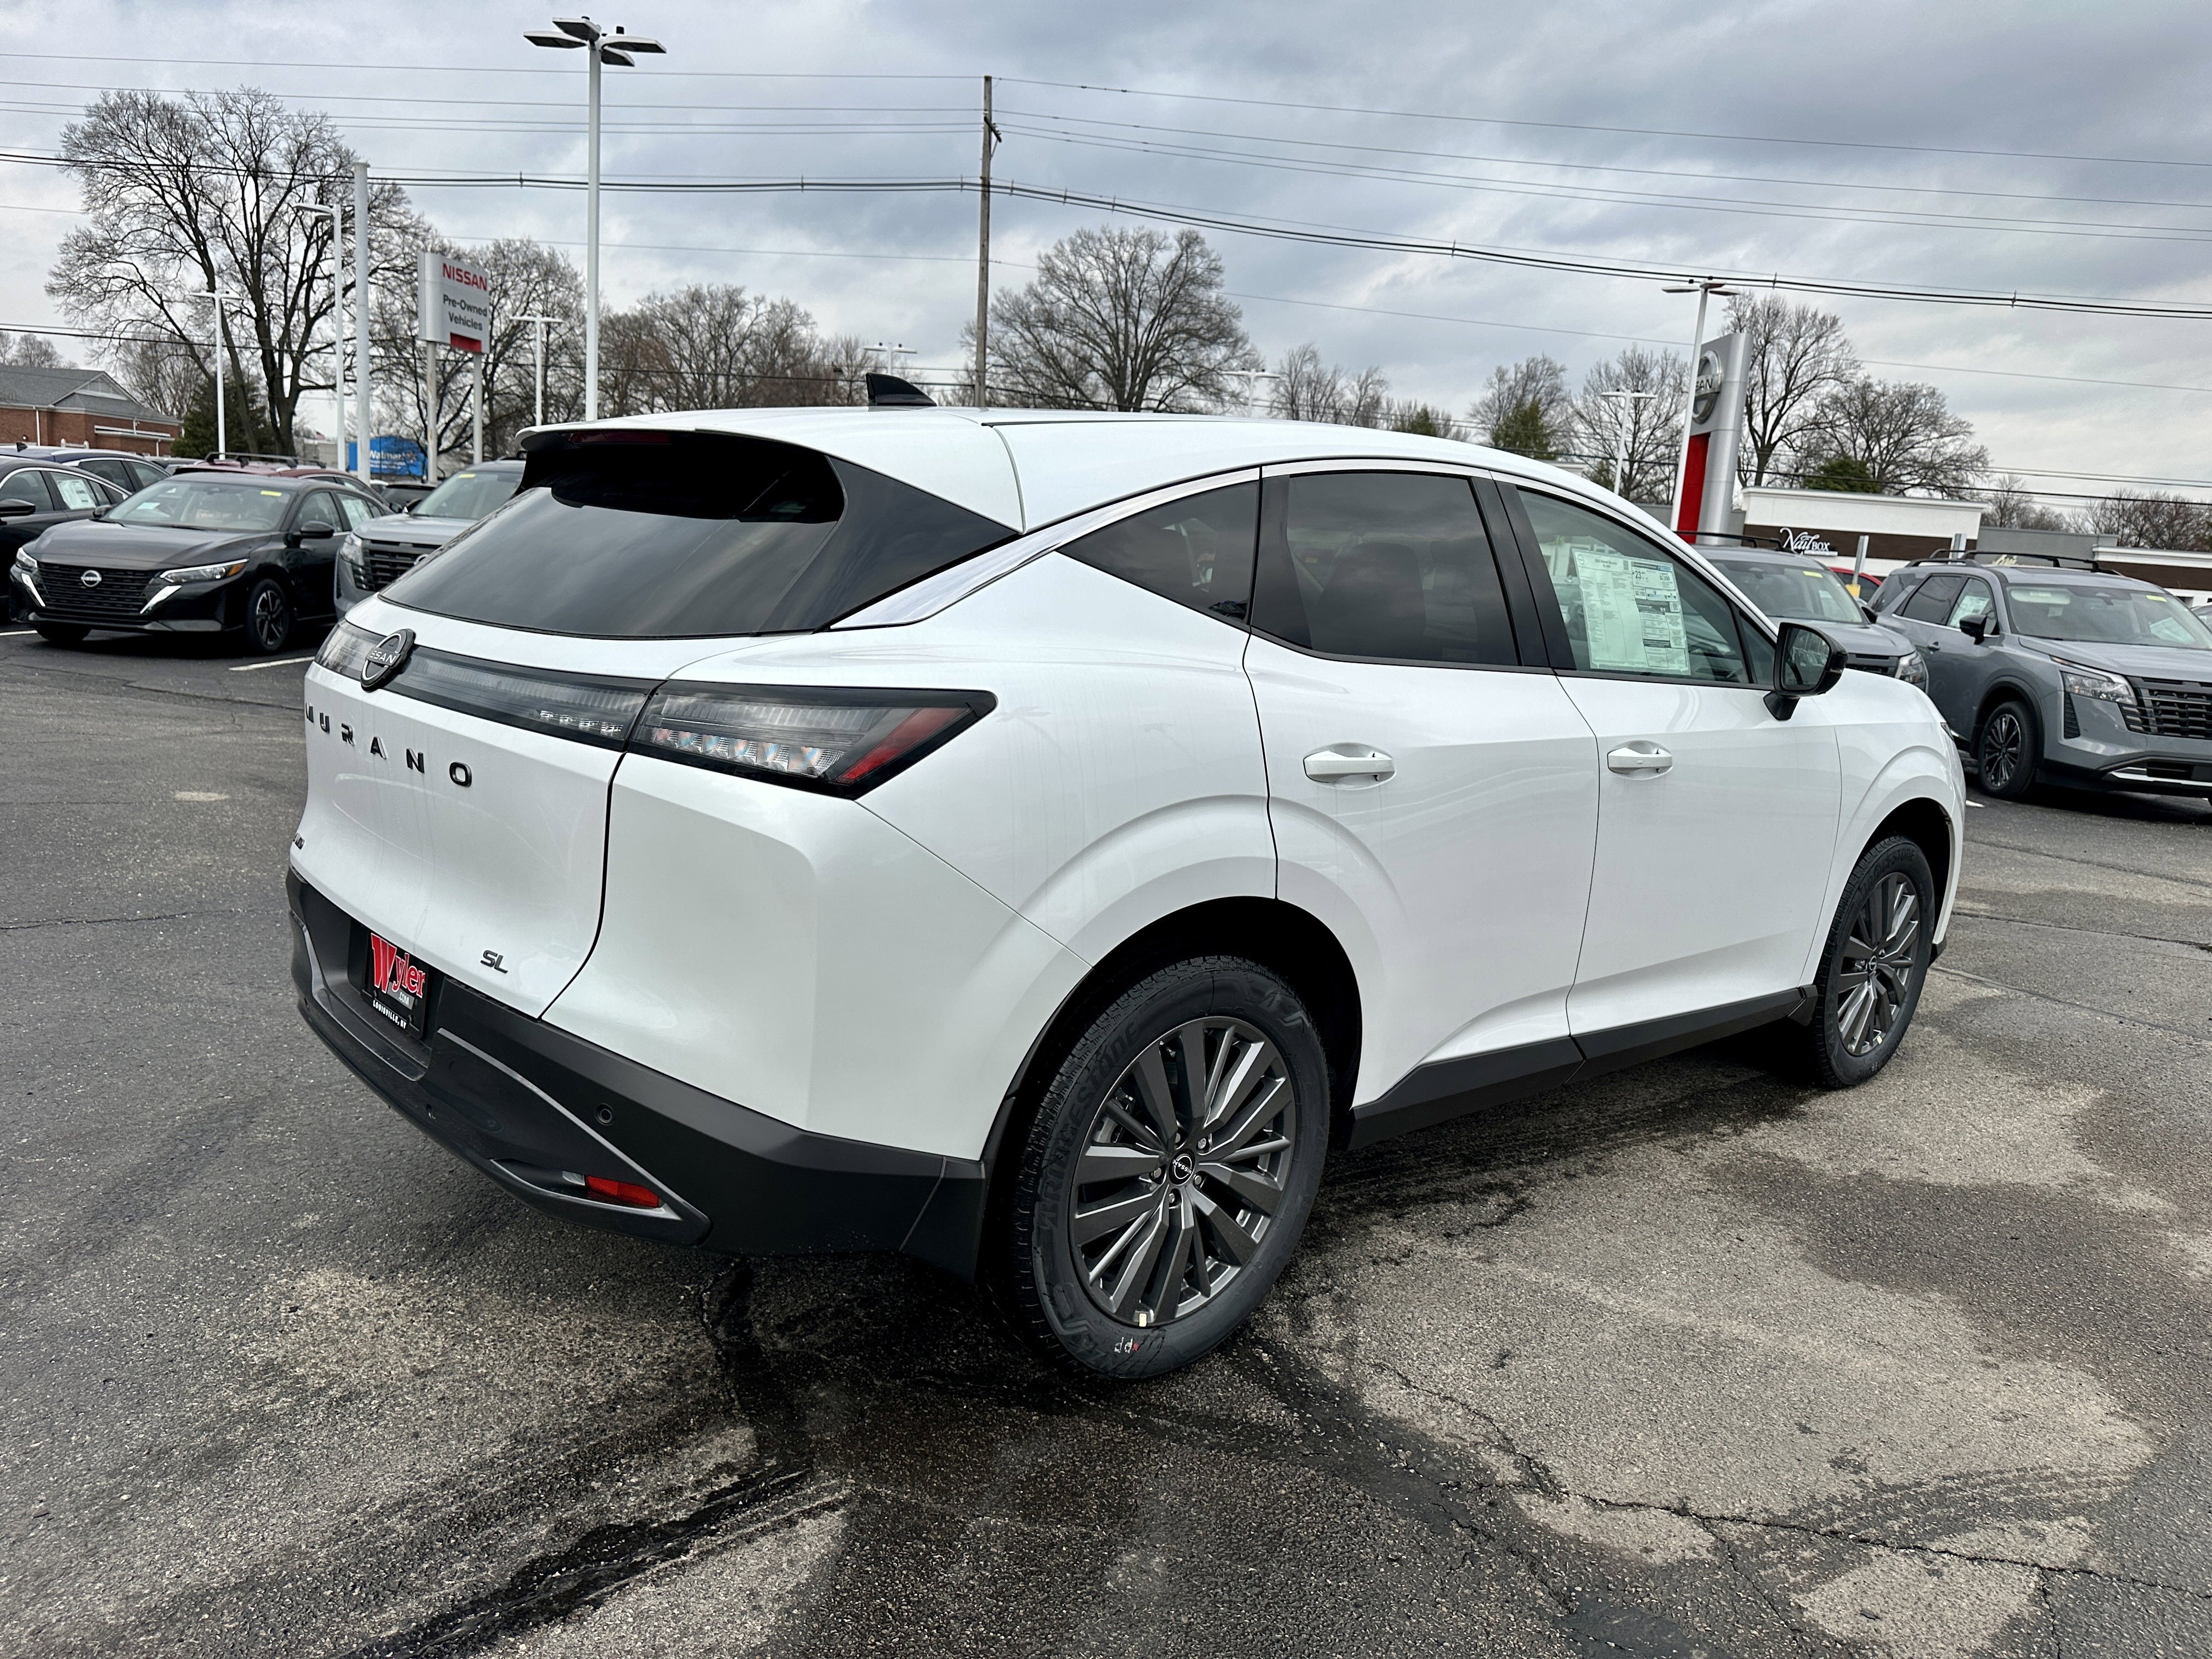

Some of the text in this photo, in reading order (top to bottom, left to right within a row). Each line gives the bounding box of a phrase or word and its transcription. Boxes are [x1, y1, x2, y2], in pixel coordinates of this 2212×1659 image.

[442, 263, 488, 291] NISSAN
[443, 294, 488, 317] Pre-Owned
[448, 312, 483, 331] Vehicles
[371, 933, 426, 998] Wyler
[481, 950, 508, 974] SL
[398, 991, 409, 1006] .COM
[373, 1000, 407, 1029] LOUISVILLE, KY
